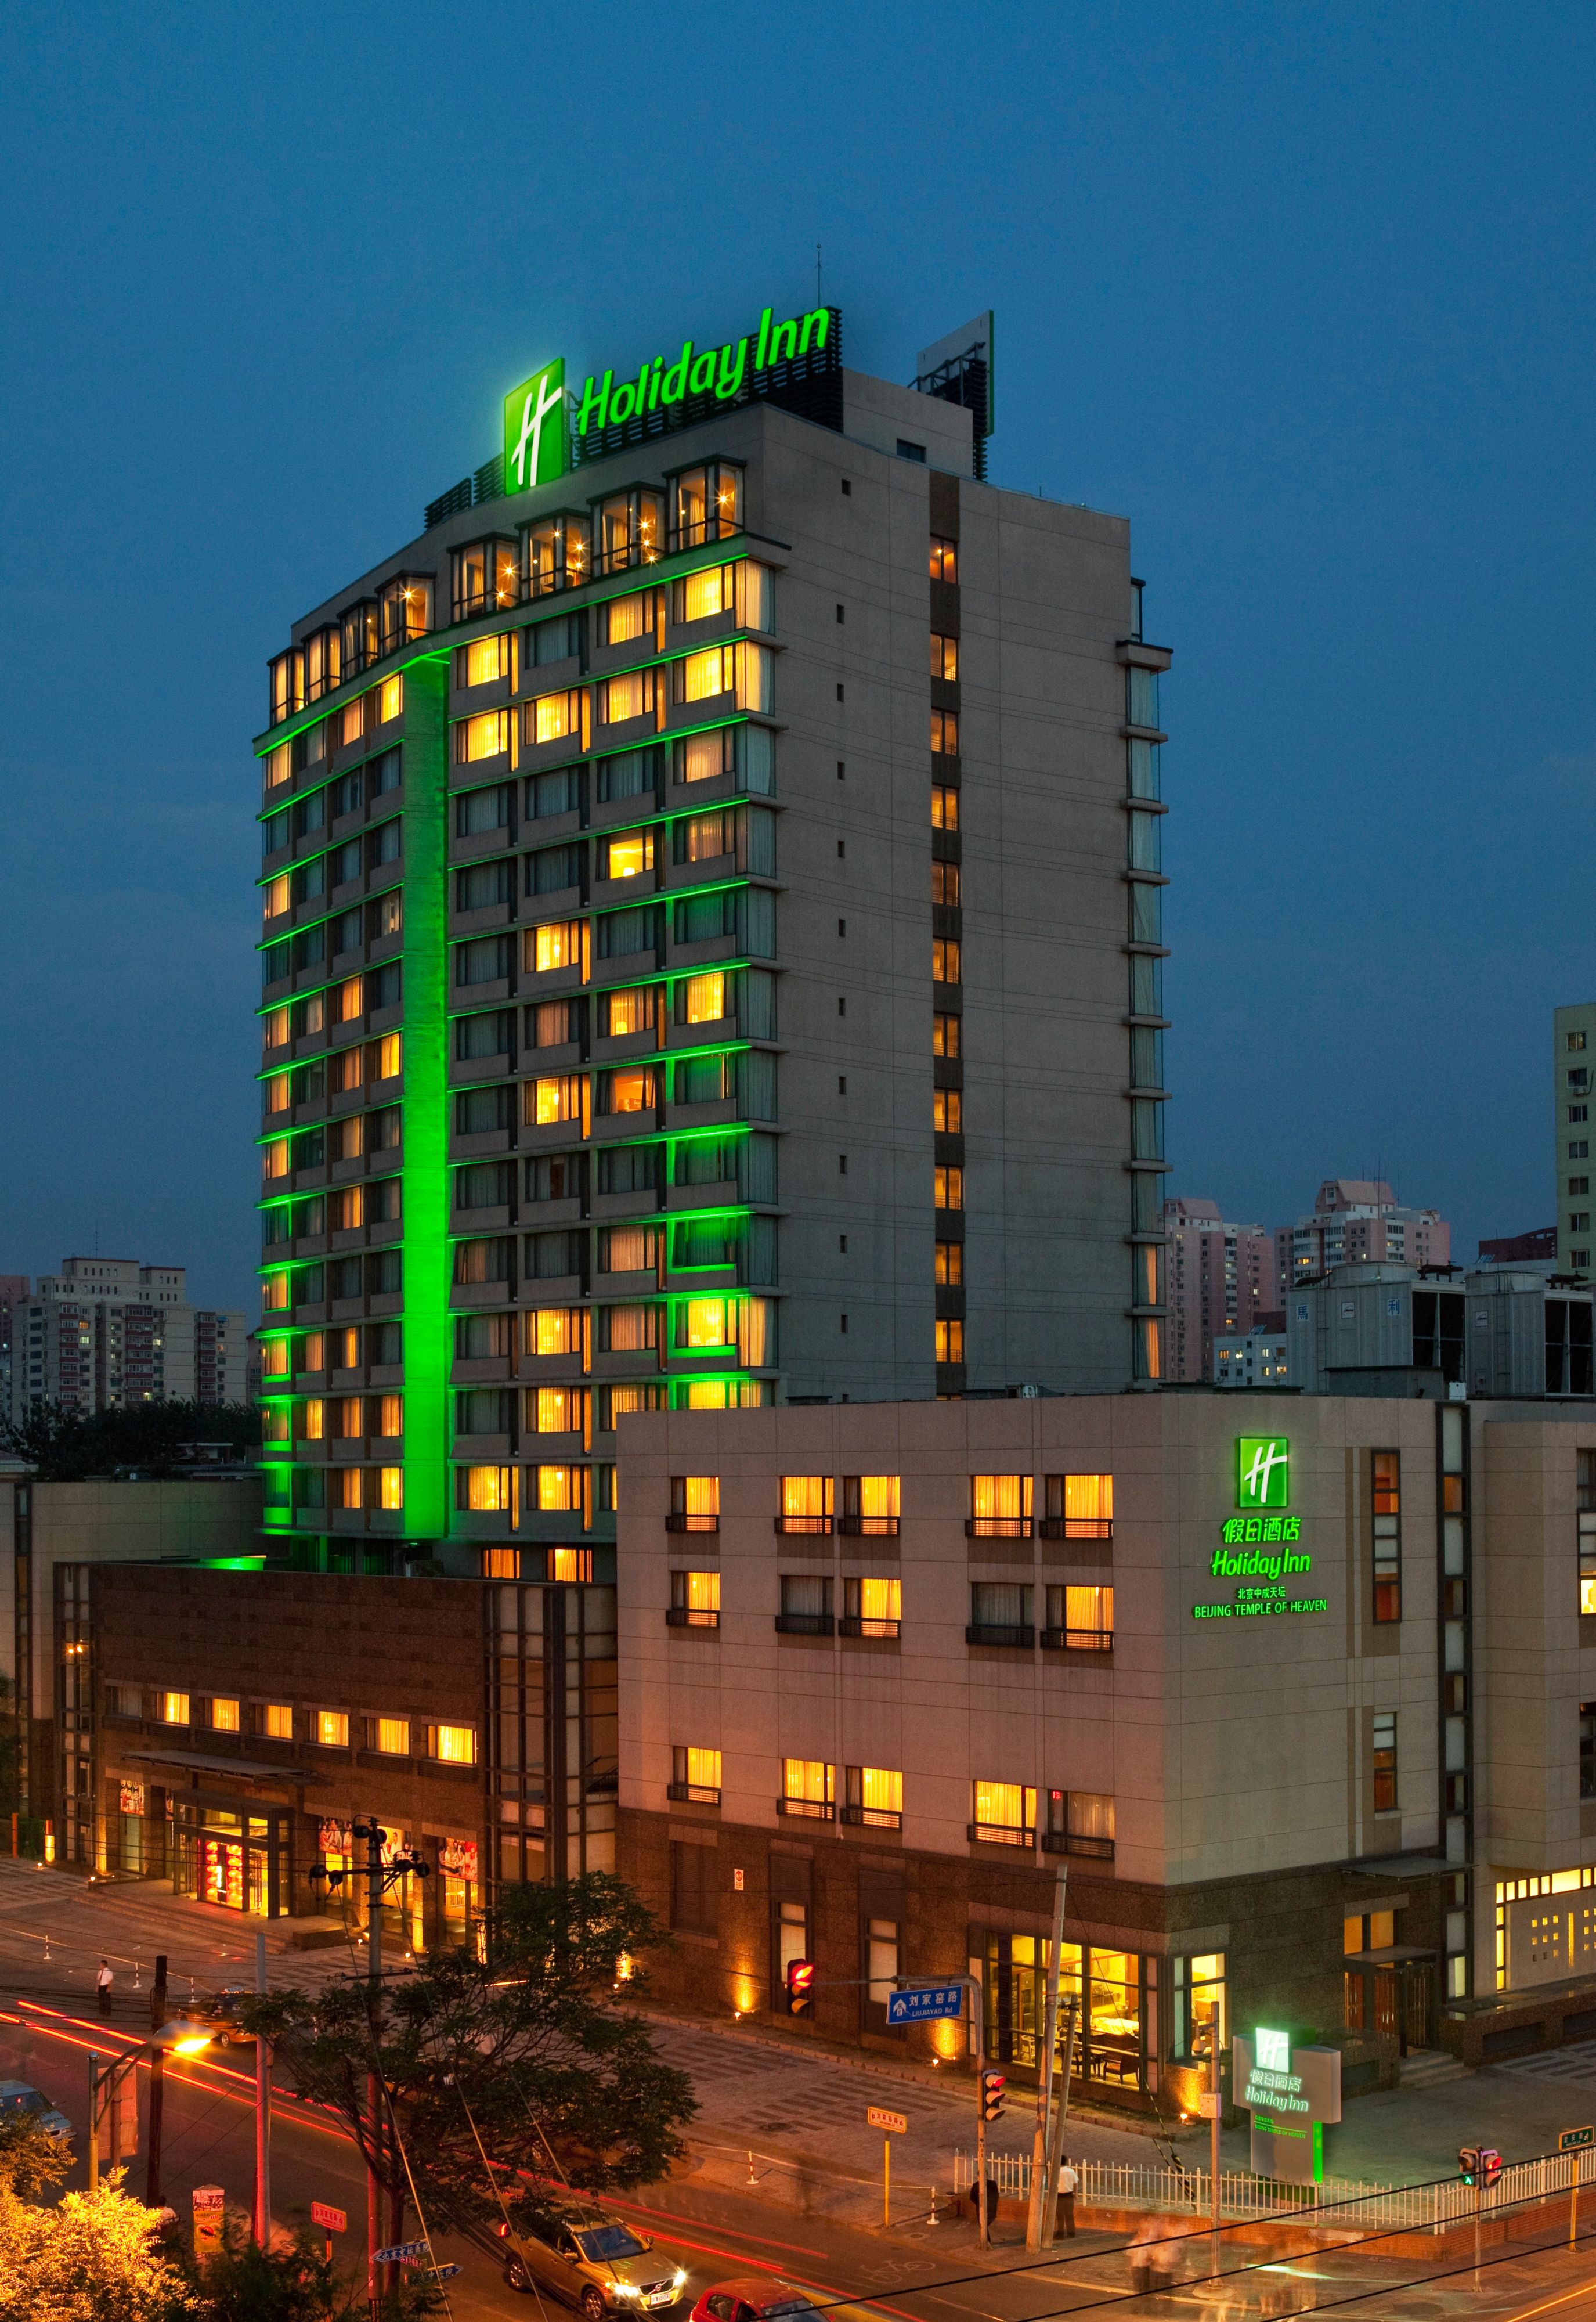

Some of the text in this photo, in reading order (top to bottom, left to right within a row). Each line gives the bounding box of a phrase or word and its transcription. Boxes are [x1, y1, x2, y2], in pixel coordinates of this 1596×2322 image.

[577, 307, 829, 435] Holiday Inn
[1297, 1306, 1308, 1320] 馬
[1388, 1299, 1400, 1315] 利
[1222, 1516, 1301, 1543] 假日酒店
[1211, 1548, 1310, 1580] Holiday Inn
[1237, 1586, 1286, 1599] 北京中成天坛
[1194, 1599, 1327, 1618] BEIJING TEMPLE OF HEAVEN
[909, 1991, 957, 2007] 刘家窑路
[912, 2008, 943, 2017] LIUJIAYAO
[1250, 2069, 1302, 2092] 假日酒店
[1245, 2085, 1309, 2112] Holiday Inn
